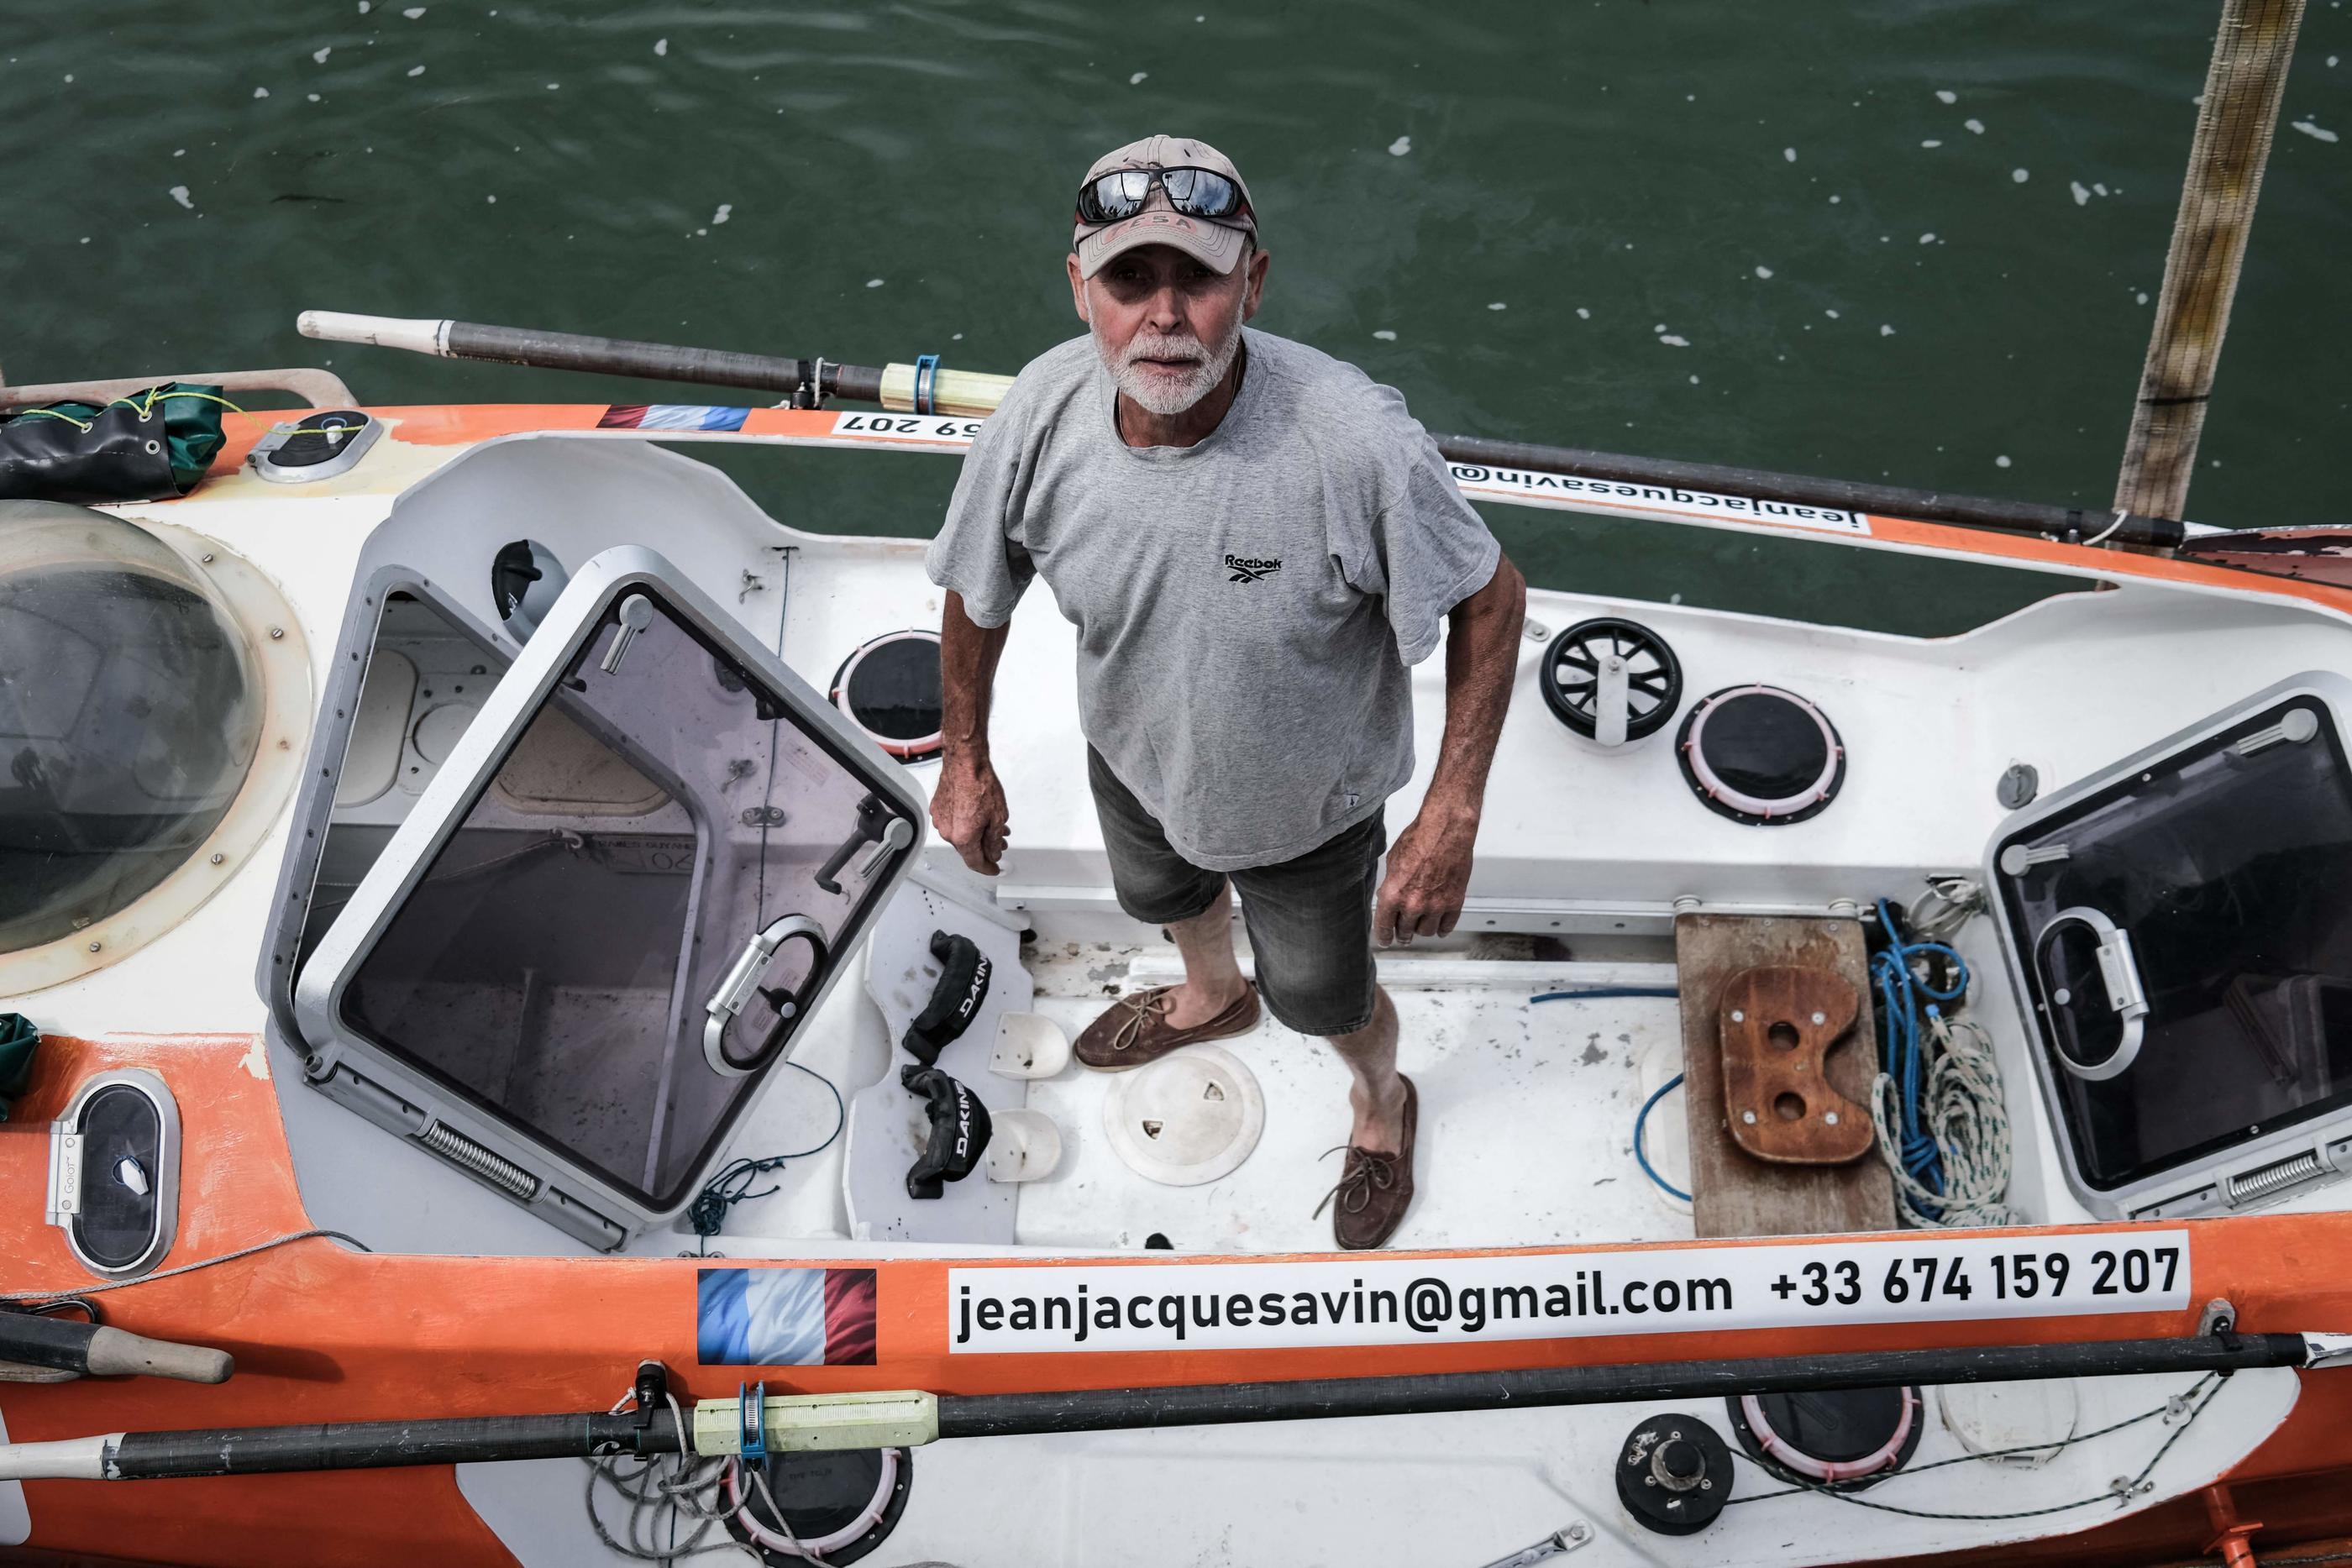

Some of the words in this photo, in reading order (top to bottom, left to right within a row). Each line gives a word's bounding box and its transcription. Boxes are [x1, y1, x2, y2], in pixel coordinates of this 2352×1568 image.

[843, 416, 921, 433] 207
[935, 422, 982, 438] 59
[1451, 464, 1860, 529] jeanjacquesavin@
[1225, 554, 1283, 569] Reebok
[957, 1270, 1733, 1344] jeanjacquesavin@gmail.com
[1770, 1260, 1861, 1306] +33
[1882, 1256, 1972, 1303] 674
[1991, 1252, 2071, 1300] 159
[2091, 1247, 2180, 1295] 207
